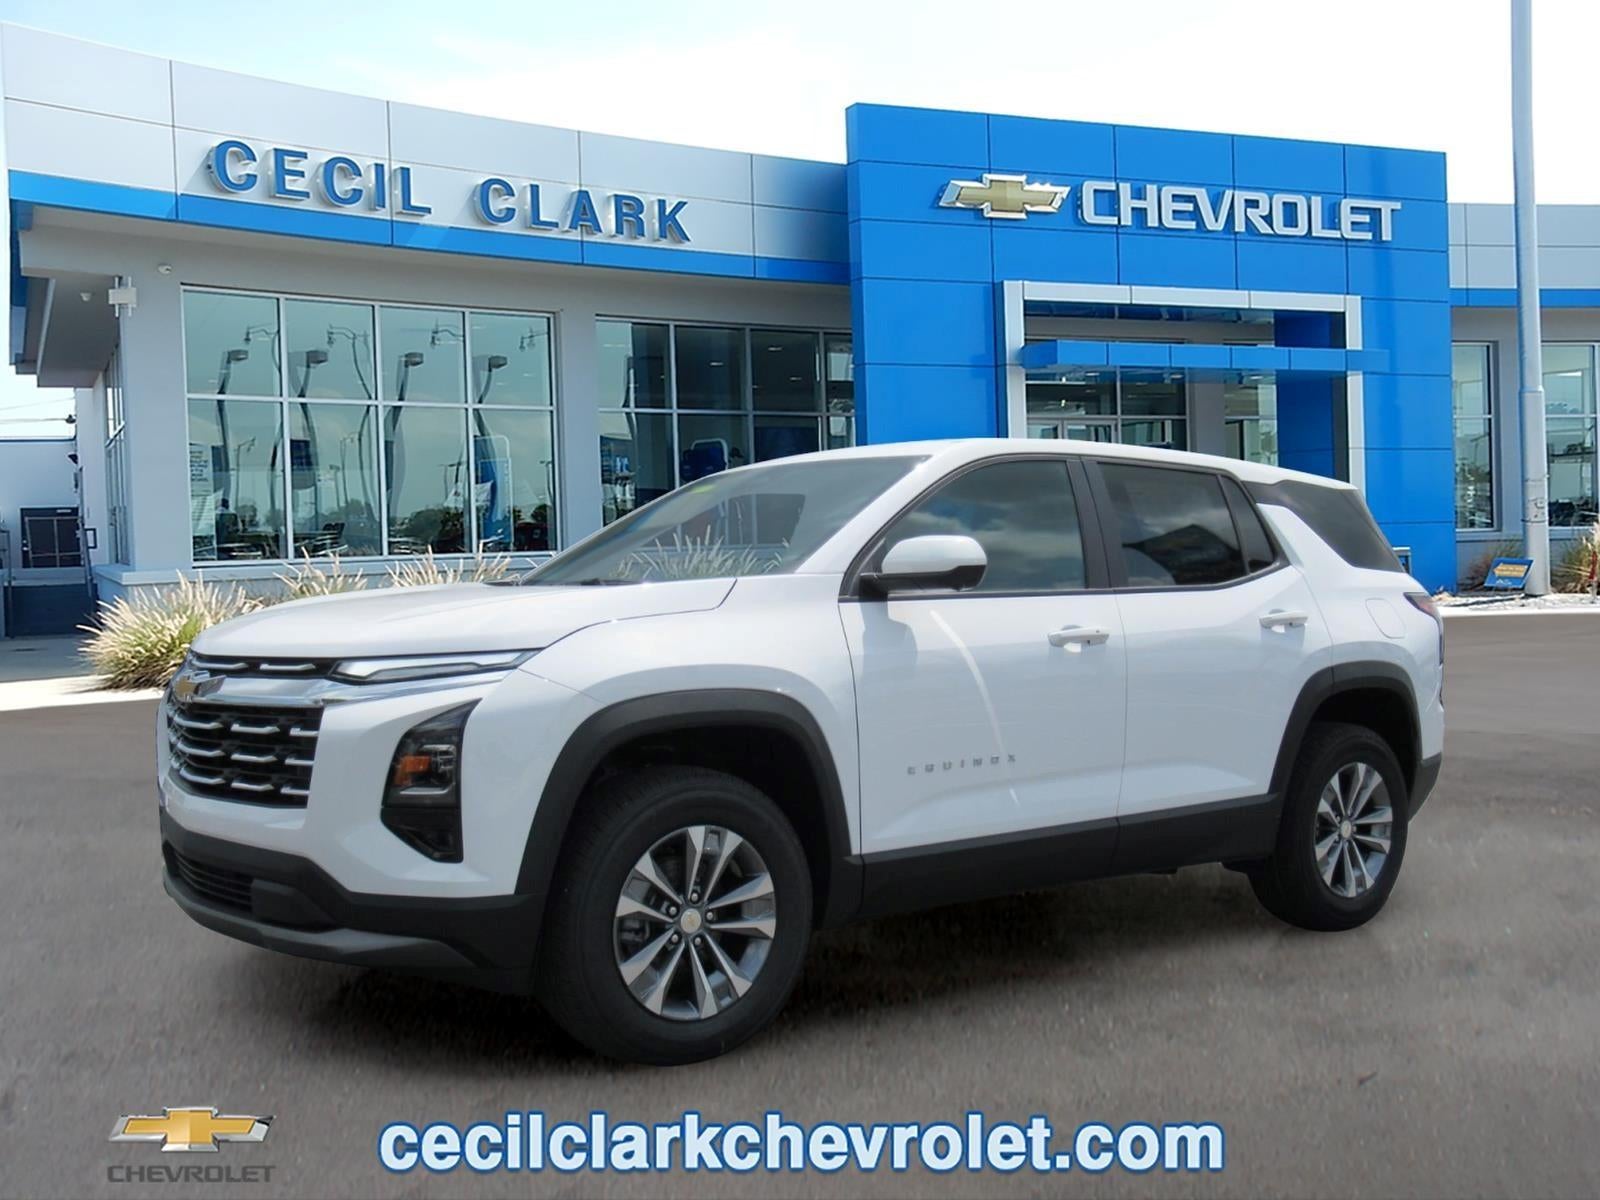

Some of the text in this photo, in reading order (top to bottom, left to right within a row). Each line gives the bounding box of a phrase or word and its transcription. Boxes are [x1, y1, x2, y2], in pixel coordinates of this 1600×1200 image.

[208, 139, 691, 243] CECIL CLARK
[1081, 180, 1402, 242] CHEVROLET
[906, 754, 1017, 776] EQUINOX
